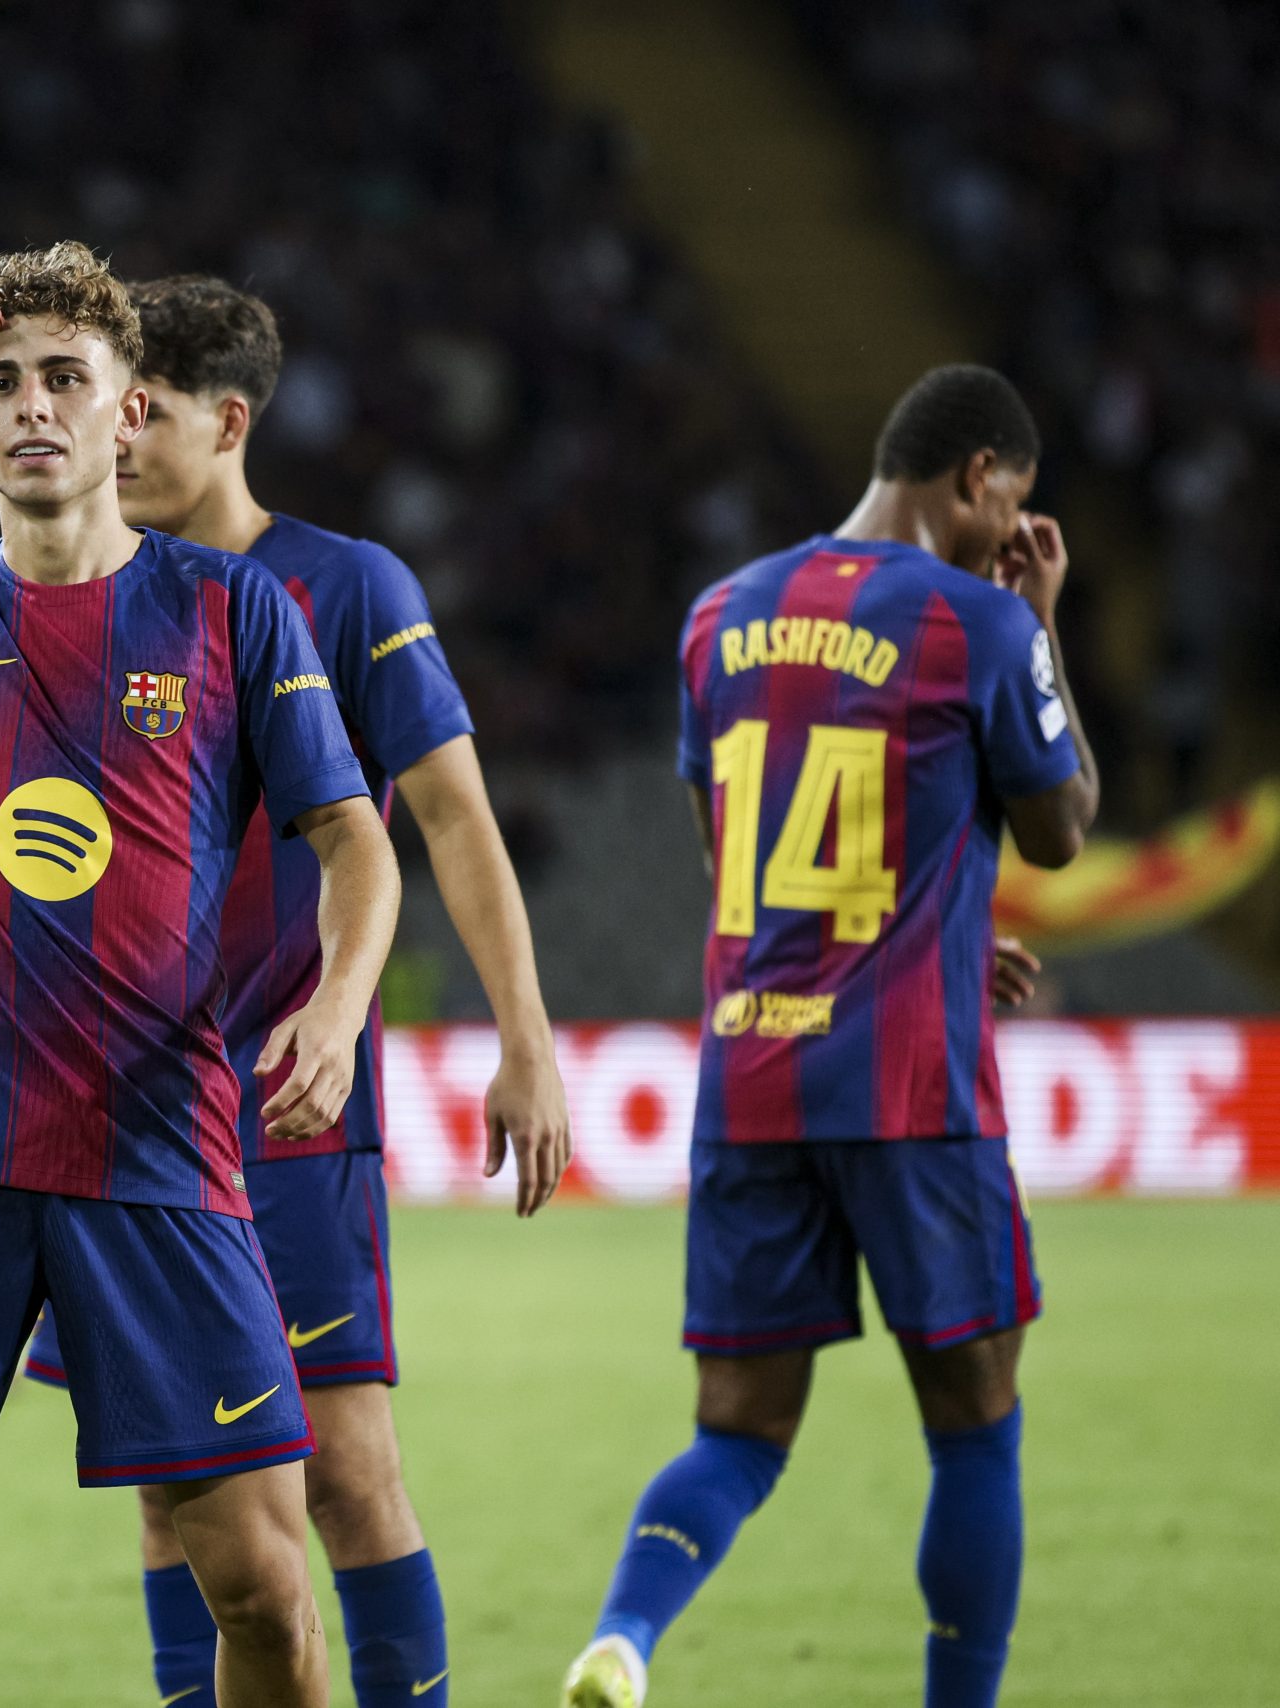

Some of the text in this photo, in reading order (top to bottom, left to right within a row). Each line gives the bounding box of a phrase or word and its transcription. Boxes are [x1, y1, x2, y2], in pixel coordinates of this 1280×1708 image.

[721, 616, 899, 687] RASHFORD
[142, 699, 167, 709] FCB
[711, 719, 896, 945] 14
